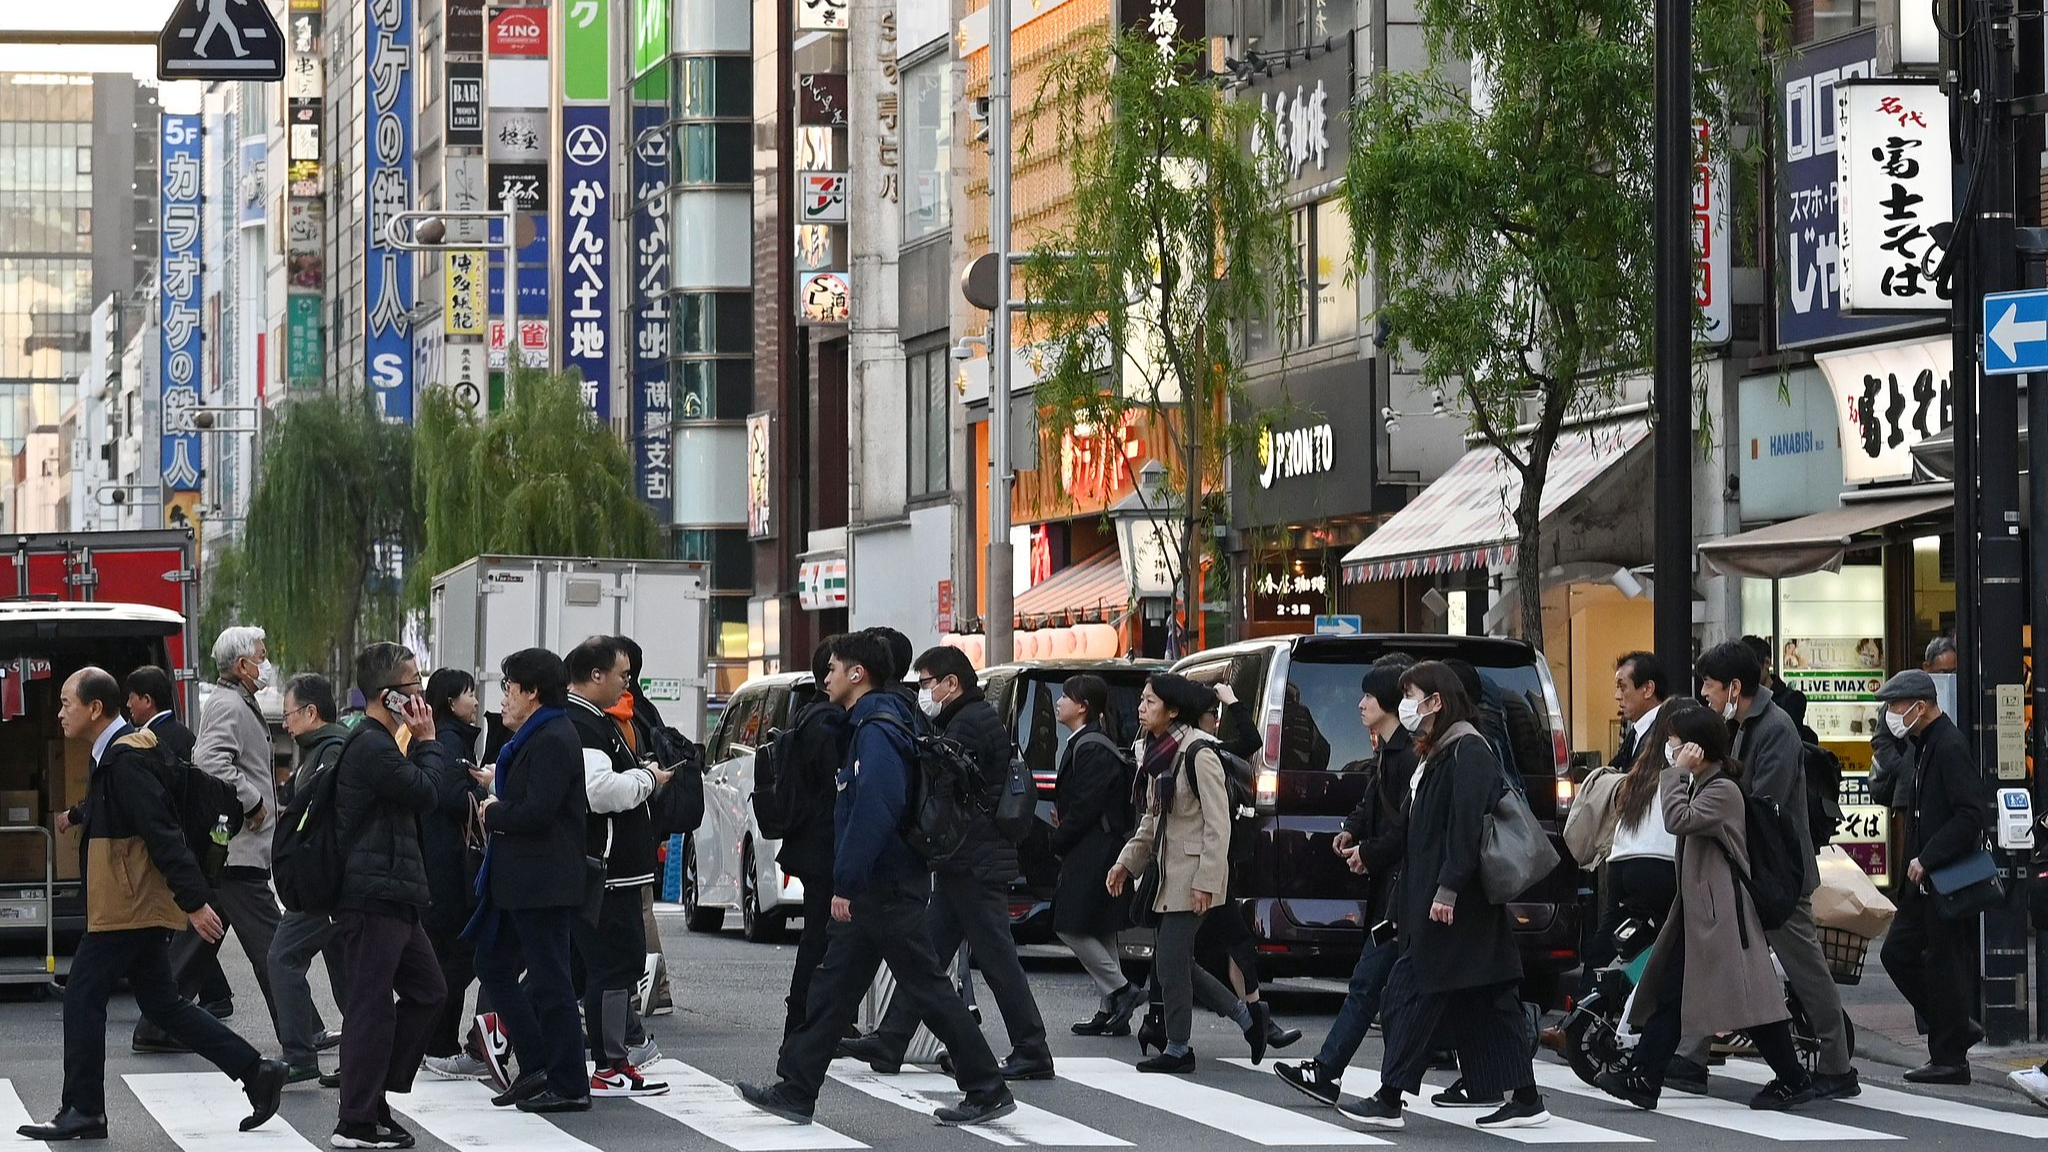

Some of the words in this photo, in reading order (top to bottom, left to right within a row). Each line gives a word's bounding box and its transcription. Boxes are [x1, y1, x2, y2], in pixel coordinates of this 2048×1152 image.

[497, 25, 540, 37] ZINO
[453, 84, 478, 102] BAR
[454, 117, 477, 125] LIGHT
[455, 107, 476, 115] MOON
[1876, 97, 1927, 128] 名代
[165, 119, 198, 145] 5F
[568, 180, 605, 359] かんべ土地
[163, 151, 200, 487] カラオケの鉄人
[1276, 423, 1333, 480] PRONTO
[1770, 431, 1813, 457] HANABISI
[1834, 680, 1865, 692] MAX
[1301, 1068, 1317, 1083] N
